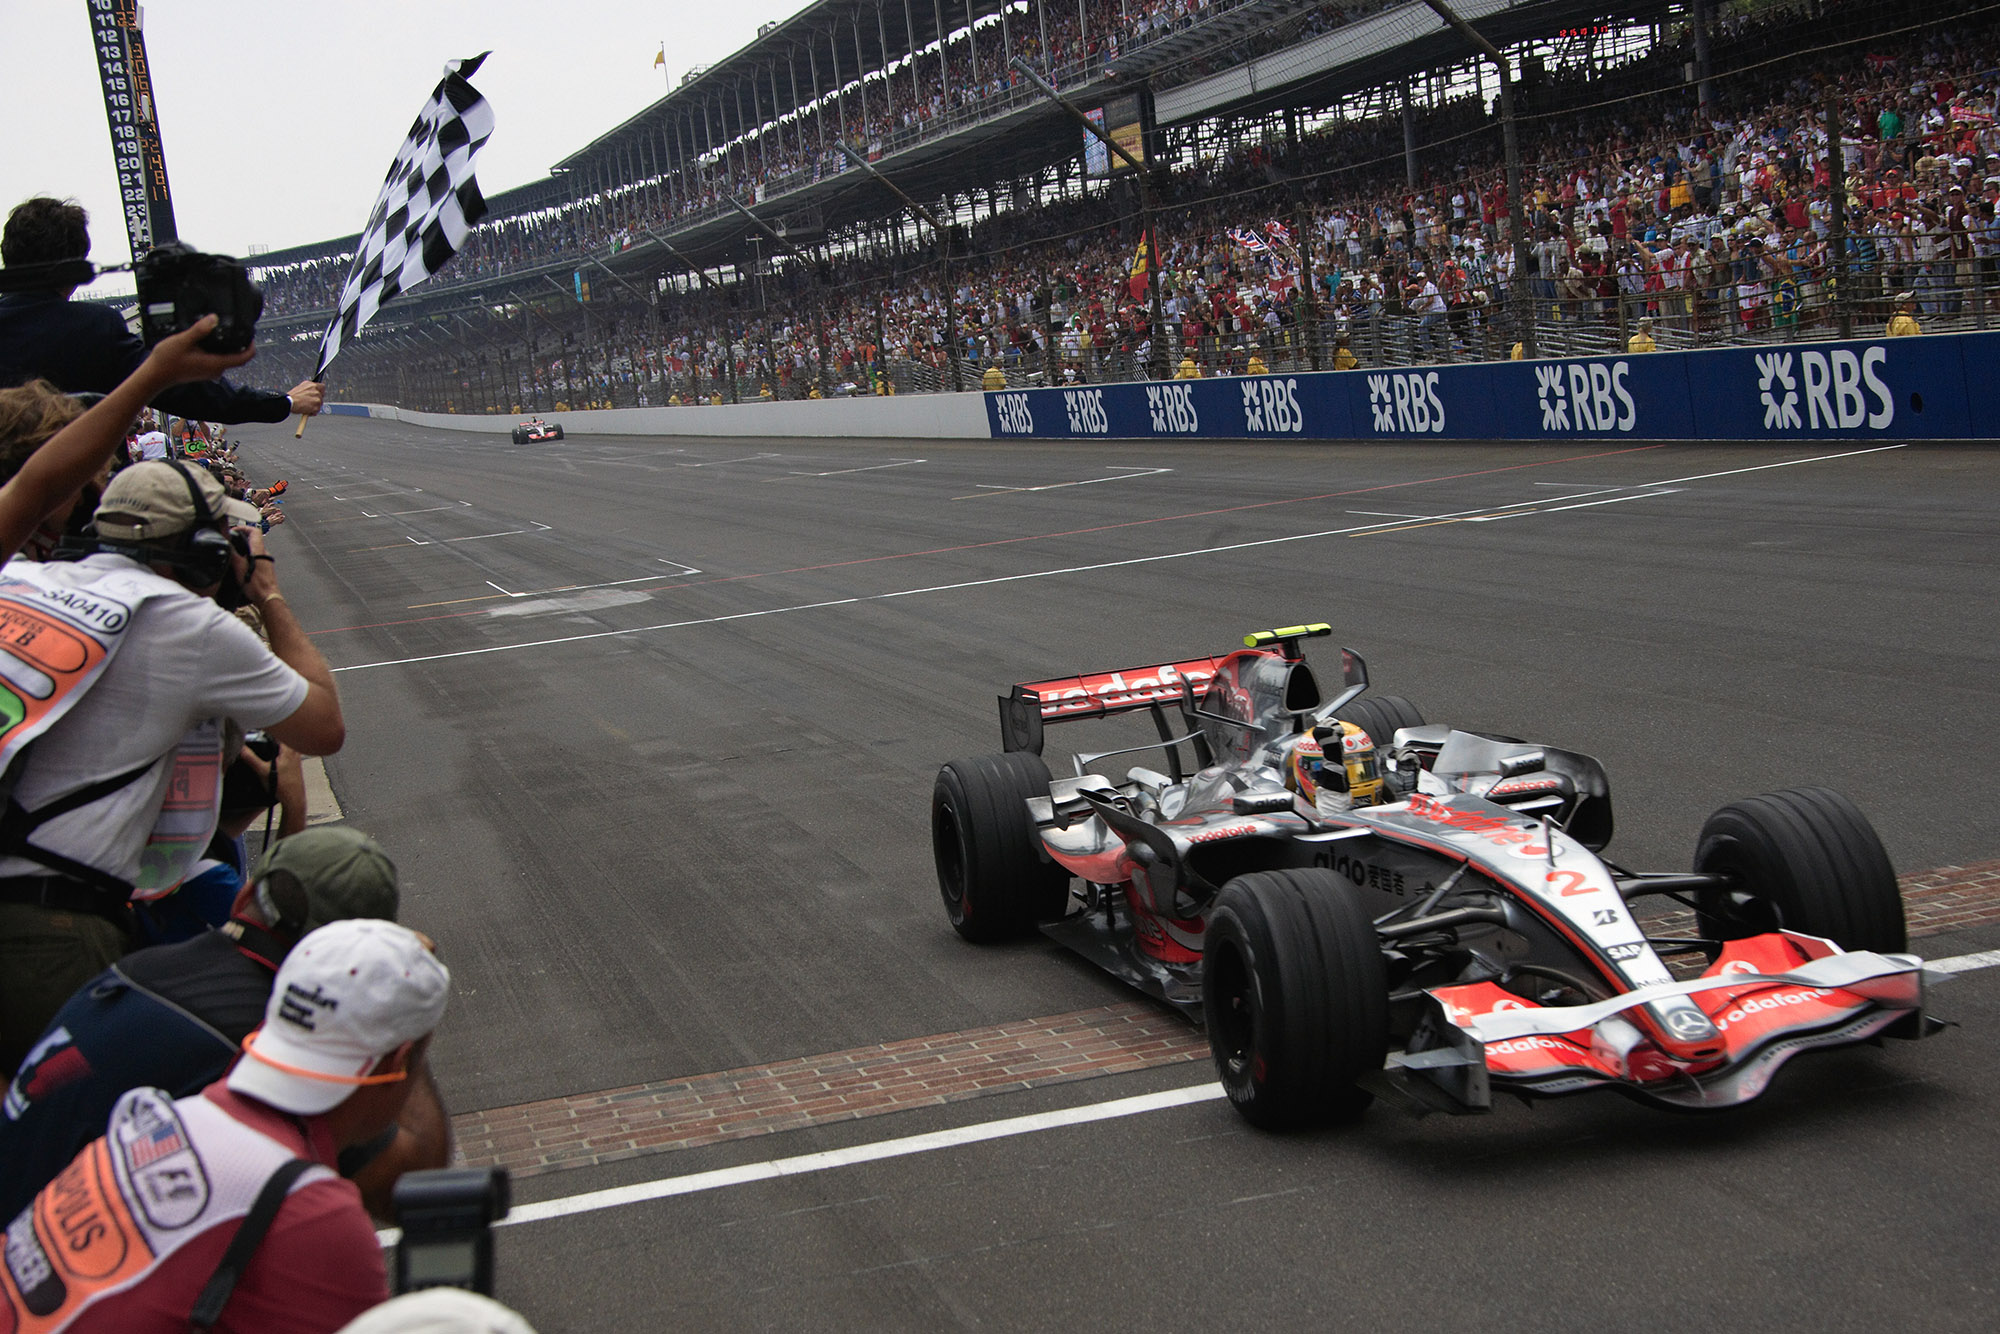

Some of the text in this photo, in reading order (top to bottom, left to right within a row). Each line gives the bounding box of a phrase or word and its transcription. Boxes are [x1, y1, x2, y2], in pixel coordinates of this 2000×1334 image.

[96, 13, 116, 26] 11
[97, 29, 119, 42] 12
[100, 45, 121, 59] 13
[103, 61, 124, 75] 14
[106, 77, 127, 91] 15
[108, 93, 129, 107] 16
[111, 109, 131, 122] 17
[114, 125, 135, 138] 18
[117, 141, 138, 154] 19
[118, 157, 140, 170] 20
[121, 172, 142, 186] 21
[124, 188, 145, 202] 22
[1801, 346, 1895, 430] RBS
[1392, 371, 1446, 433] RBS
[1567, 361, 1636, 432] RBS
[1006, 393, 1034, 434] RBS
[1078, 389, 1109, 433] RBS
[1162, 383, 1199, 433] RBS
[1260, 378, 1303, 433] RBS
[1041, 665, 1212, 712] vodafo
[1489, 779, 1557, 795] odafone
[1186, 823, 1257, 844] vodafone
[1545, 870, 1601, 897] 2
[1607, 945, 1642, 961] SAP
[1716, 987, 1835, 1031] vodafone
